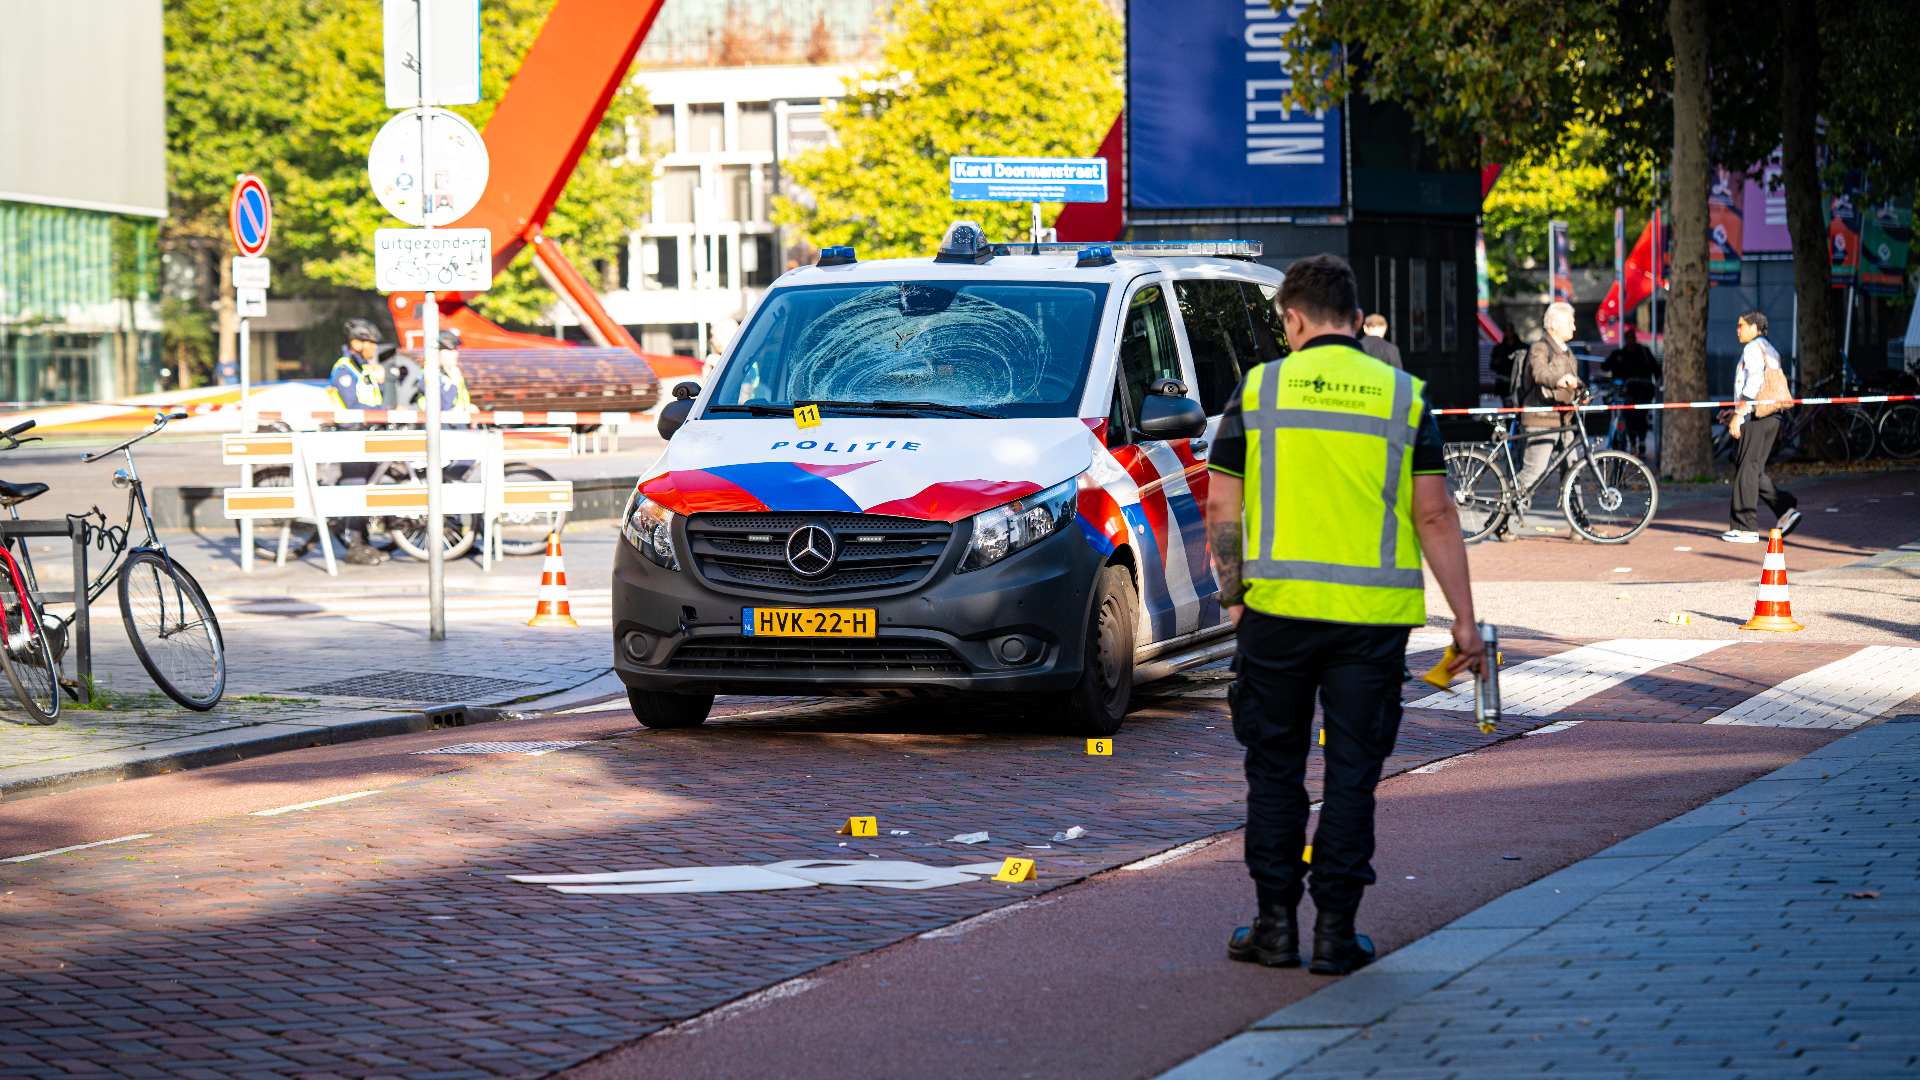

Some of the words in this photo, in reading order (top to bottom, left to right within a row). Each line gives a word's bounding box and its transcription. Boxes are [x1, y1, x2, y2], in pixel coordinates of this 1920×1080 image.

[956, 163, 992, 177] Karel
[994, 163, 1100, 178] Doormanstraat
[381, 237, 486, 253] uitgezonderd
[1302, 395, 1366, 409] FO-VERKEER
[798, 408, 816, 423] 11
[771, 440, 921, 453] POLITIE
[760, 611, 866, 633] HVK-22-H
[1095, 741, 1104, 754] 6
[859, 820, 868, 834] 7
[1009, 862, 1022, 876] 8
